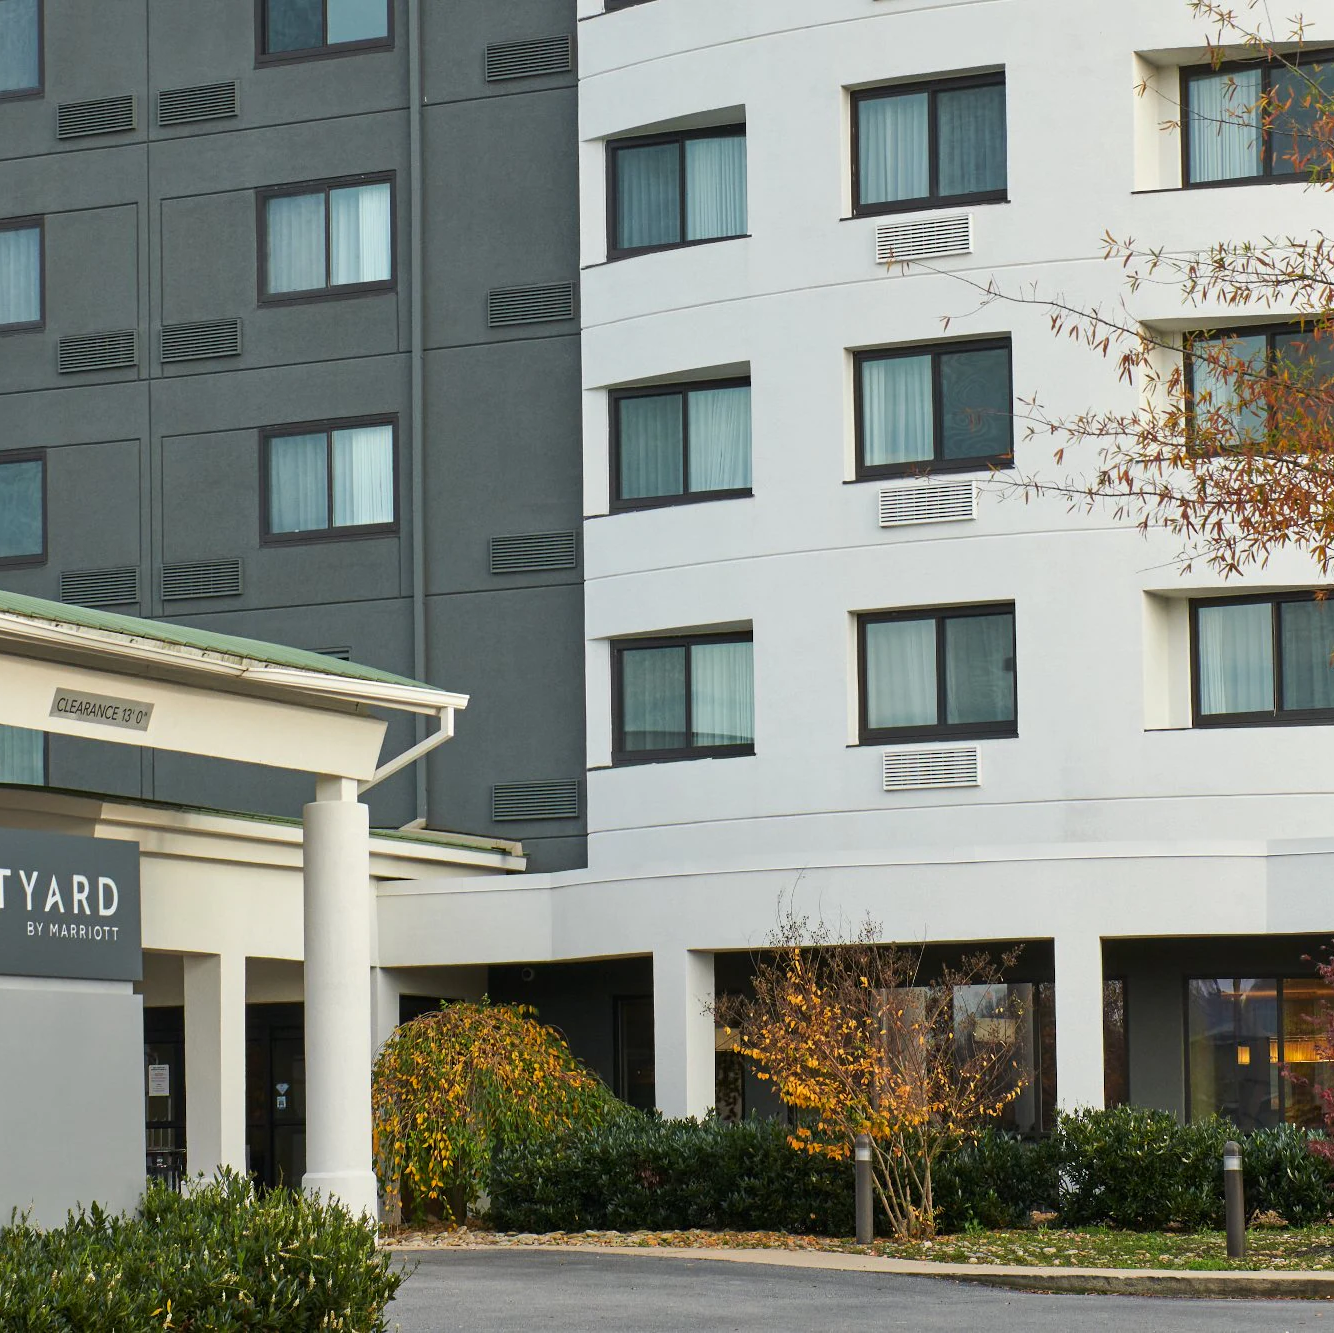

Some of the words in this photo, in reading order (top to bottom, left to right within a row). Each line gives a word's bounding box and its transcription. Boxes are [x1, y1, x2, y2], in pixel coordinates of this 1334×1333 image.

[56, 697, 120, 721] CLEARANCE
[26, 921, 44, 936] BY
[49, 923, 119, 941] MARRIOTT
